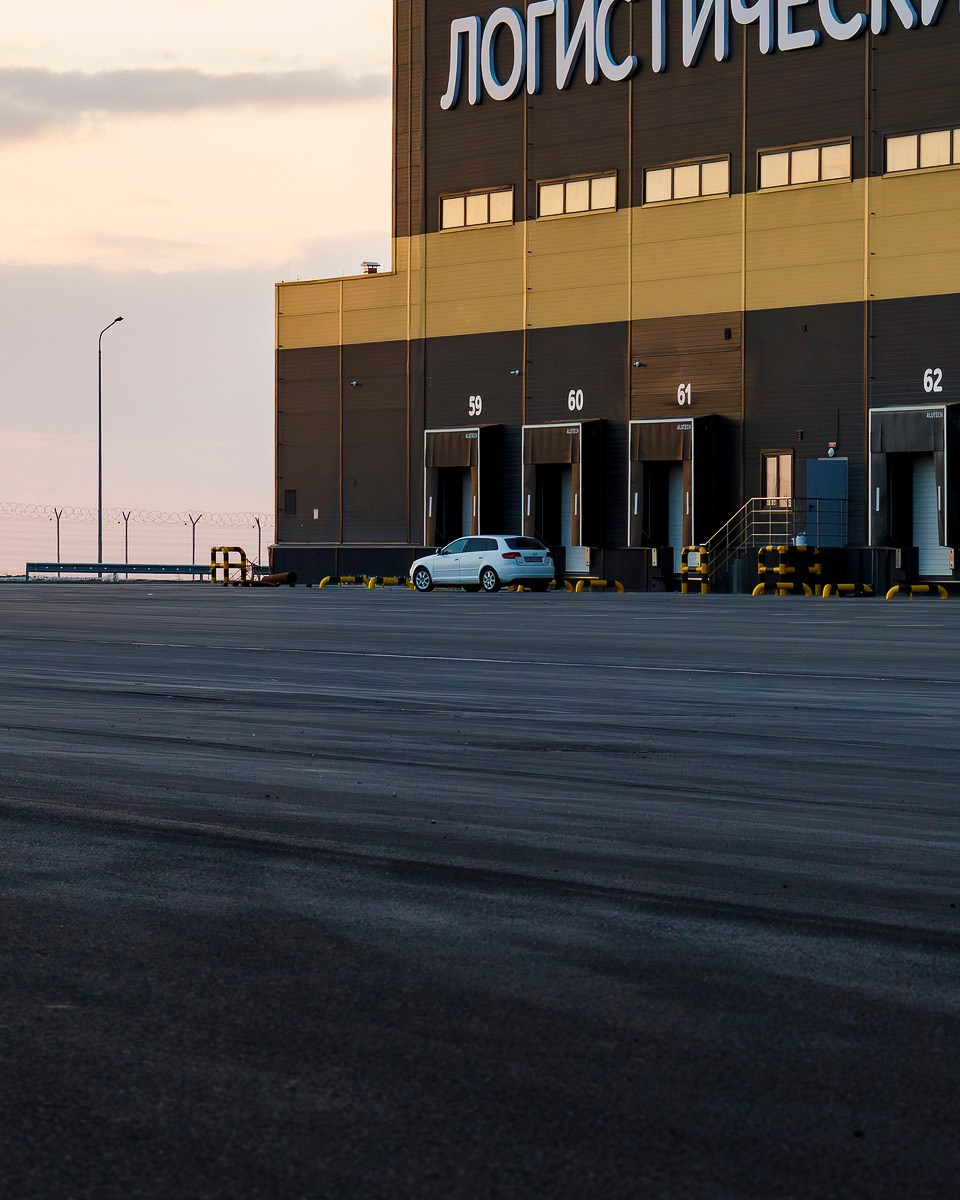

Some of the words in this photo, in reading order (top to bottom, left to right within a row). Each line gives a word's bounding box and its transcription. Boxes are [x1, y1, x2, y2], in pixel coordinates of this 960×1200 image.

[923, 367, 943, 393] 62
[468, 394, 483, 417] 59
[567, 388, 584, 412] 60
[677, 382, 692, 406] 61
